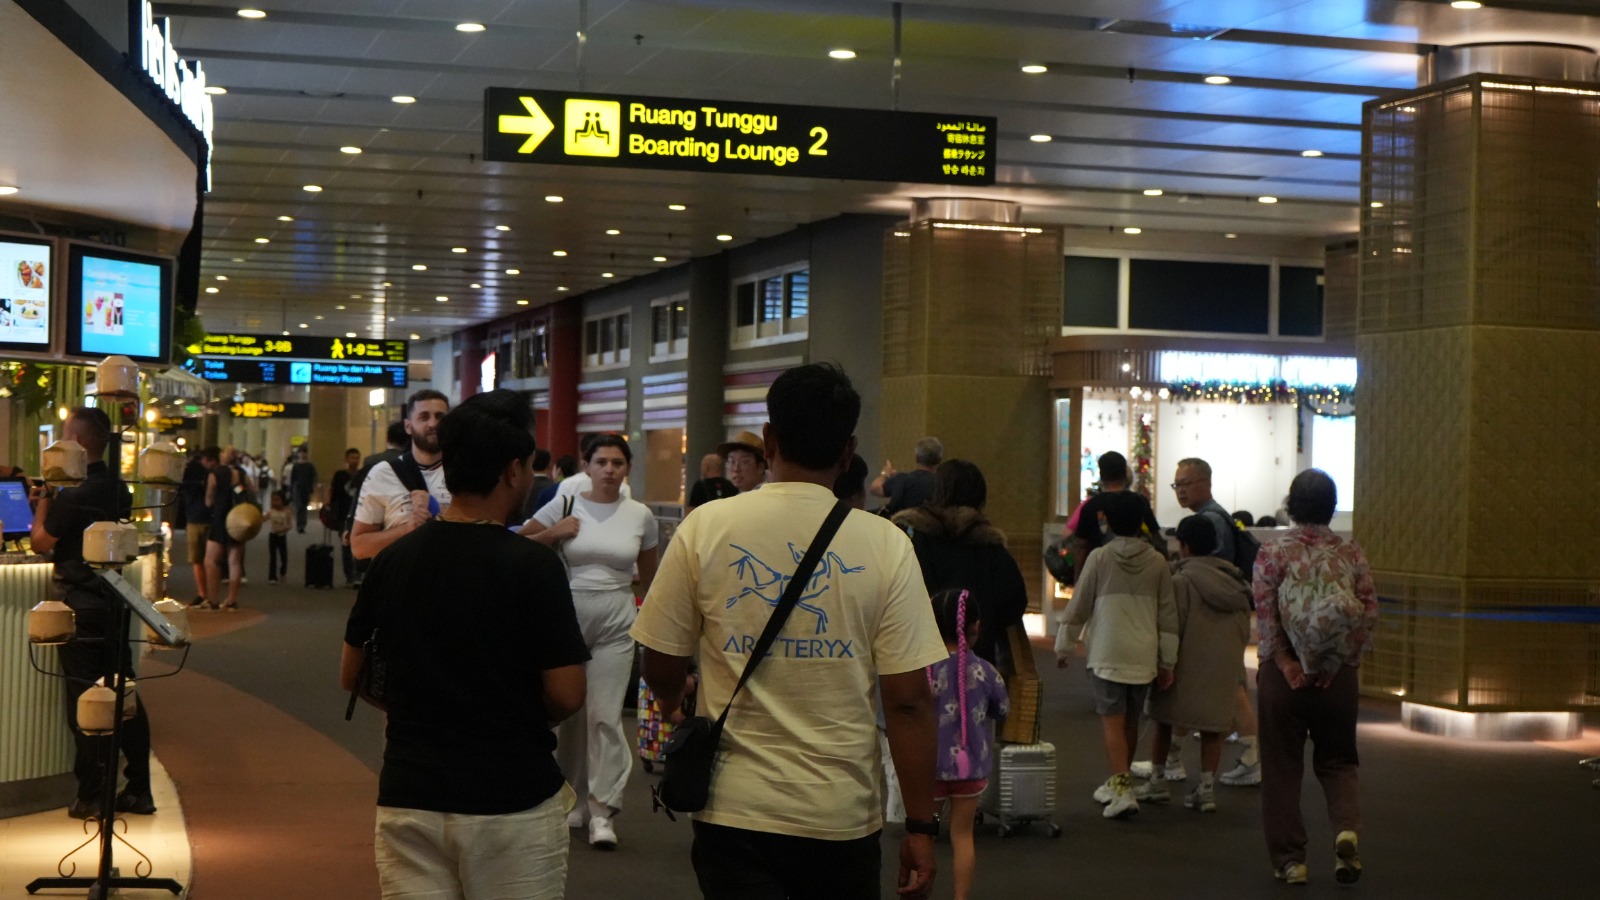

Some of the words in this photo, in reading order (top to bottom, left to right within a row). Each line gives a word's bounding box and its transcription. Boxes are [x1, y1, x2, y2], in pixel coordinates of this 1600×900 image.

[629, 102, 697, 131] Ruang
[701, 106, 778, 135] Tunggu
[807, 126, 829, 156] 2
[629, 134, 720, 163] Boarding
[724, 139, 800, 167] Lounge
[229, 335, 257, 345] Tunggu
[236, 347, 264, 356] Lounge
[204, 360, 225, 370] Toilet
[312, 363, 338, 374] Ruang
[349, 365, 364, 374] dan
[364, 366, 383, 375] Anak
[204, 370, 228, 380] Toilets
[312, 374, 341, 384] Nursery
[341, 375, 363, 385] Room
[722, 634, 854, 658] AR'TERYX
